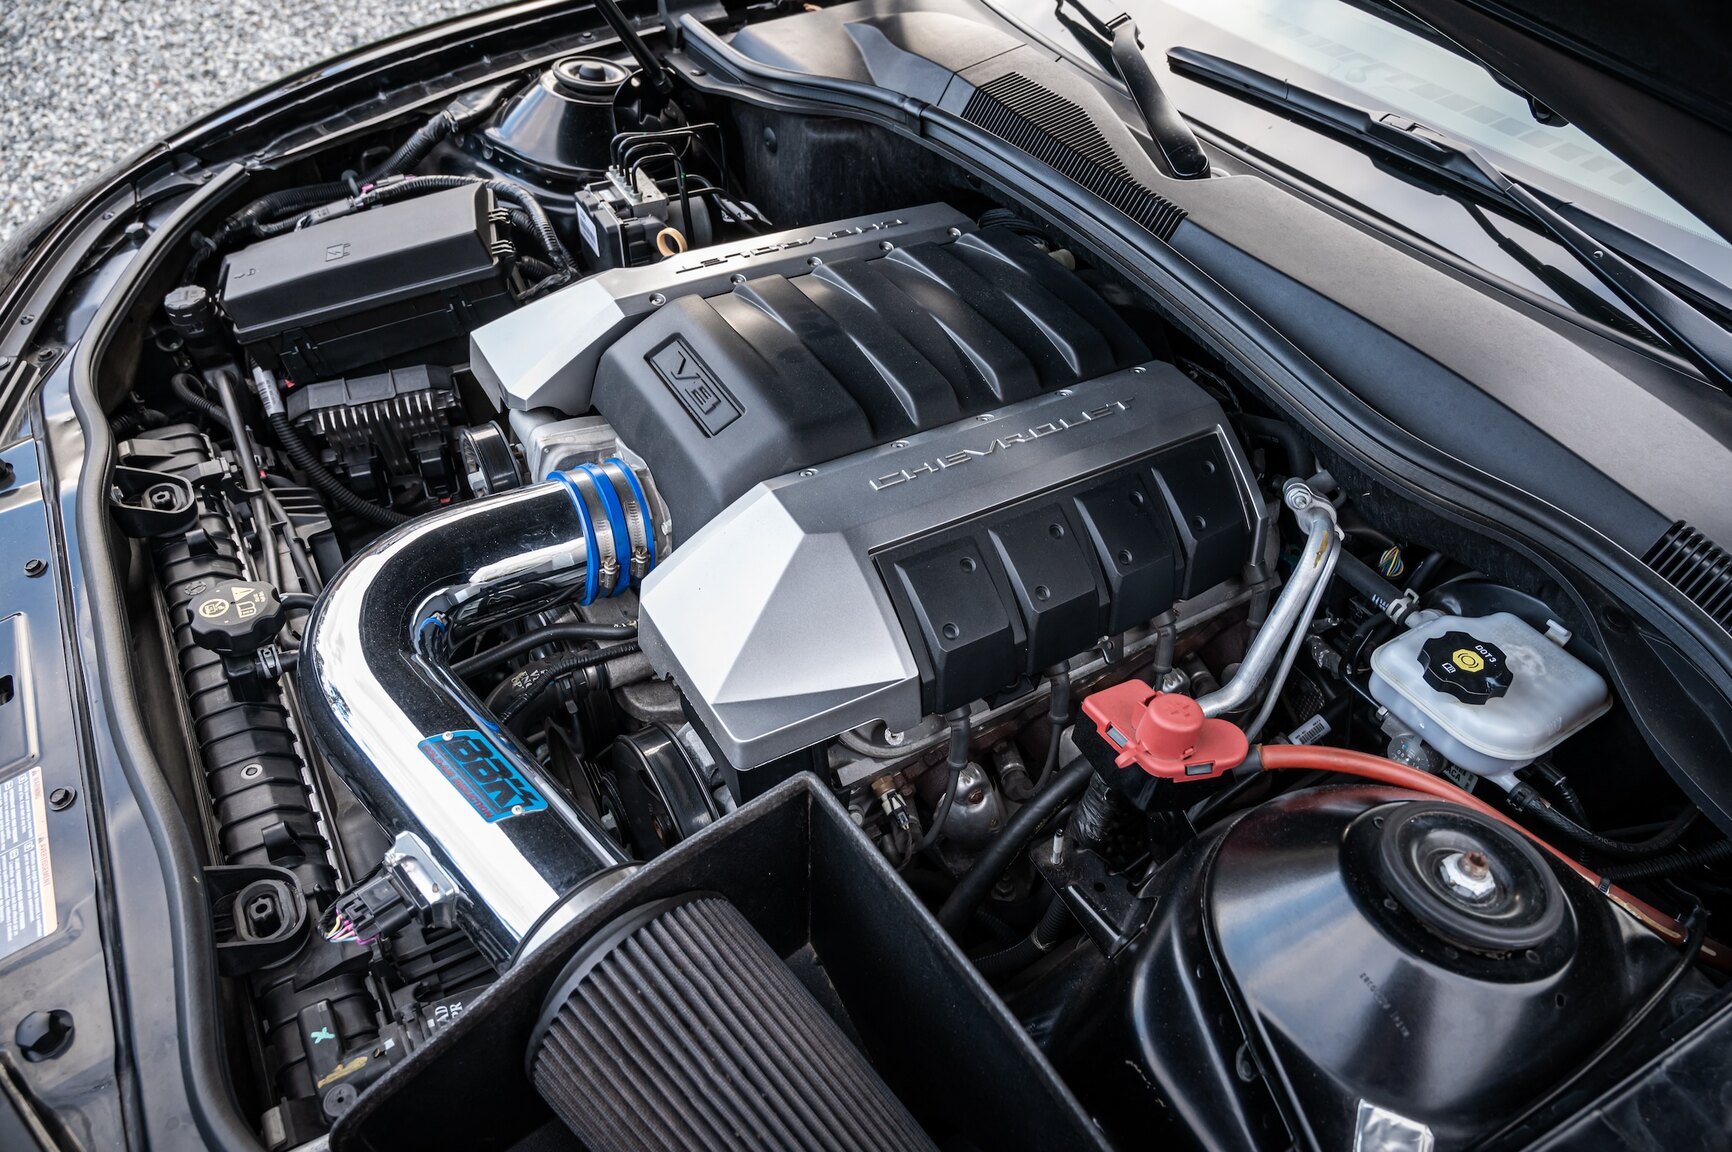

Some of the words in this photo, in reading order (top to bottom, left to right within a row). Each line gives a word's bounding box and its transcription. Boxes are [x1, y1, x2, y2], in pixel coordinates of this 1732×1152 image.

[676, 218, 909, 274] CHEVROLET
[869, 397, 1135, 491] CHEVROLET
[440, 736, 540, 808] BBK
